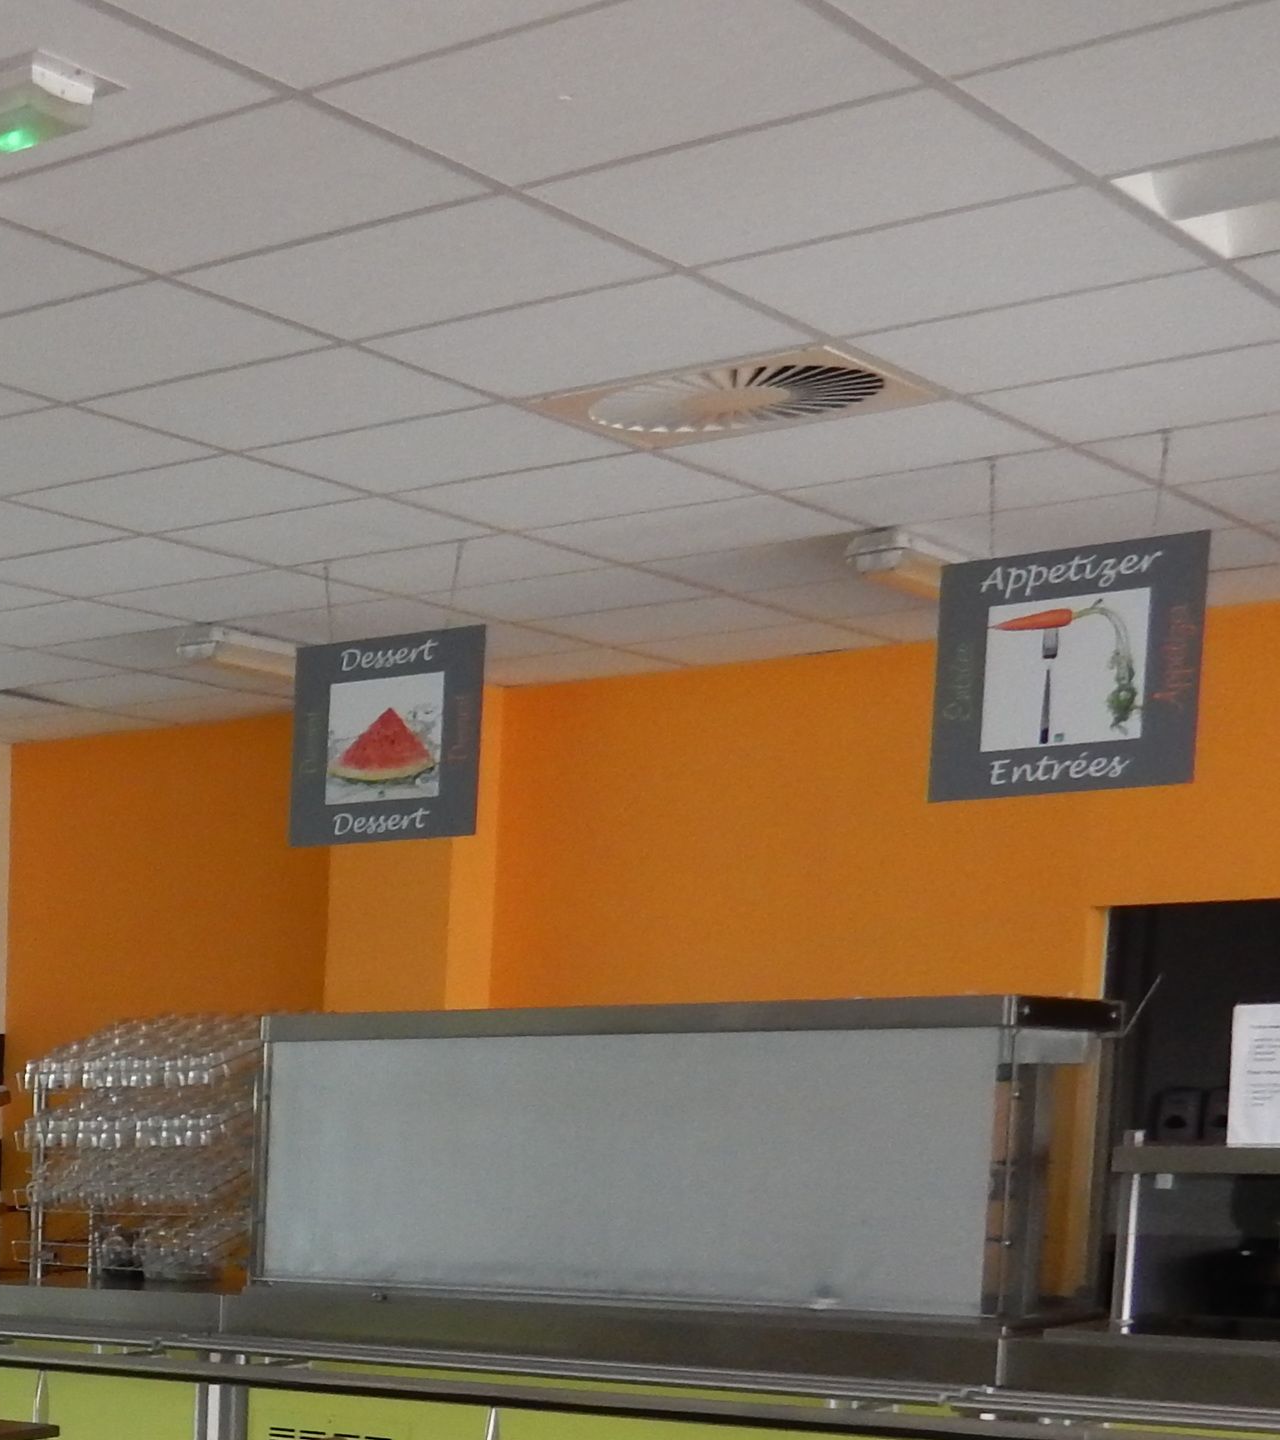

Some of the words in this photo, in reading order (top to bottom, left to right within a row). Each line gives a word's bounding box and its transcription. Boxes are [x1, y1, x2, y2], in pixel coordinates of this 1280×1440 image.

[979, 550, 1164, 598] Appetizer
[340, 638, 439, 672] Dessert
[990, 751, 1131, 786] Entrées
[332, 807, 430, 836] Dessert
